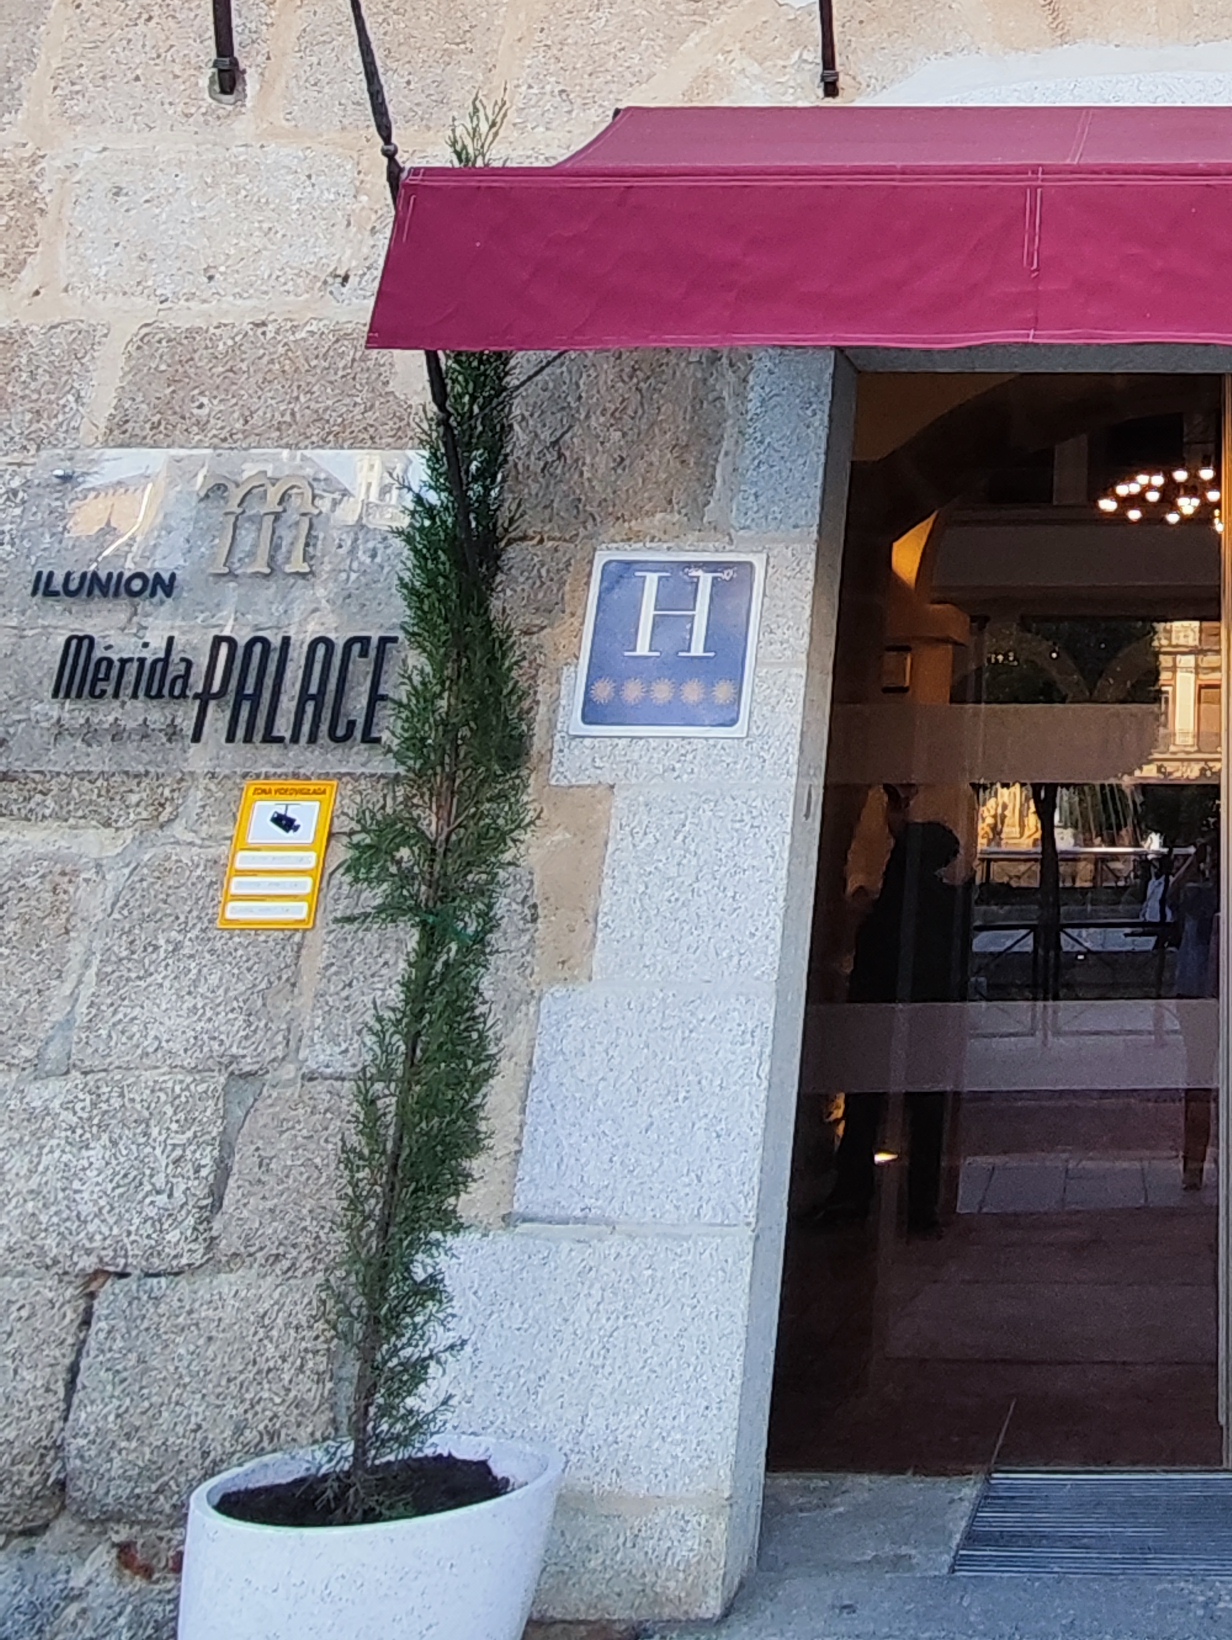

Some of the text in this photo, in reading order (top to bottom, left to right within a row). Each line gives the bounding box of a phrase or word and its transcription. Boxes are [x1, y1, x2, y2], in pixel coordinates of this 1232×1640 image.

[30, 570, 177, 599] ILUNION
[623, 571, 724, 658] H
[51, 635, 399, 744] Mérida PALACE
